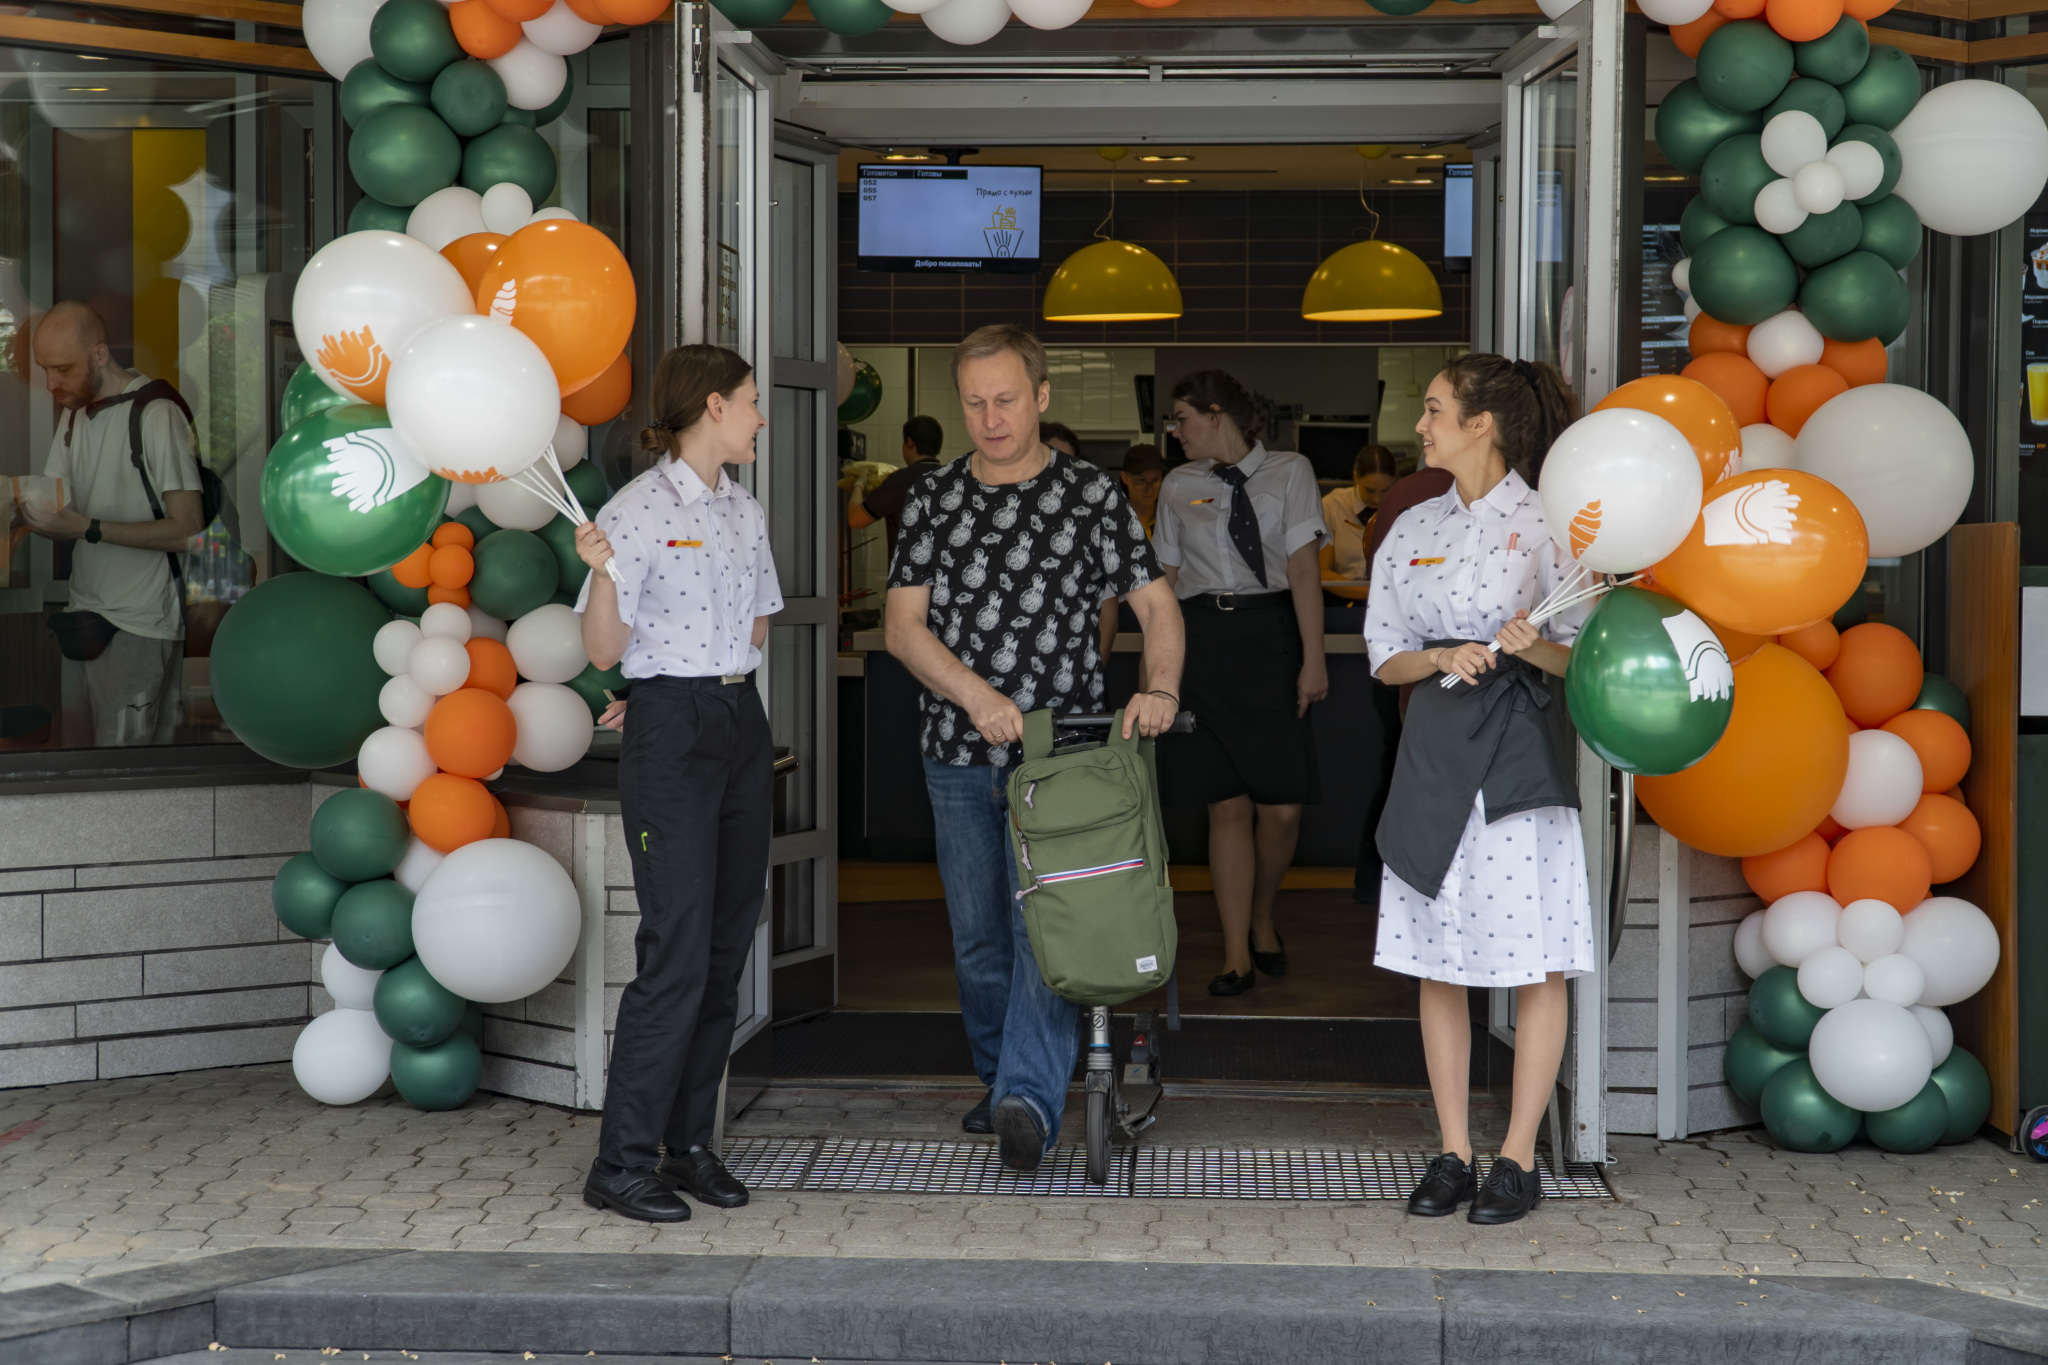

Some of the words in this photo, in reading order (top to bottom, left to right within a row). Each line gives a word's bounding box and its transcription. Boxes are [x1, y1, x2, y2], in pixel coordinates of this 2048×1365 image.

[863, 169, 898, 177] Готовятся
[917, 169, 943, 177] Готовы
[976, 187, 1002, 199] Прямо
[1009, 189, 1033, 198] кухни
[915, 259, 938, 268] Добро
[938, 260, 982, 268] пожаловать!
